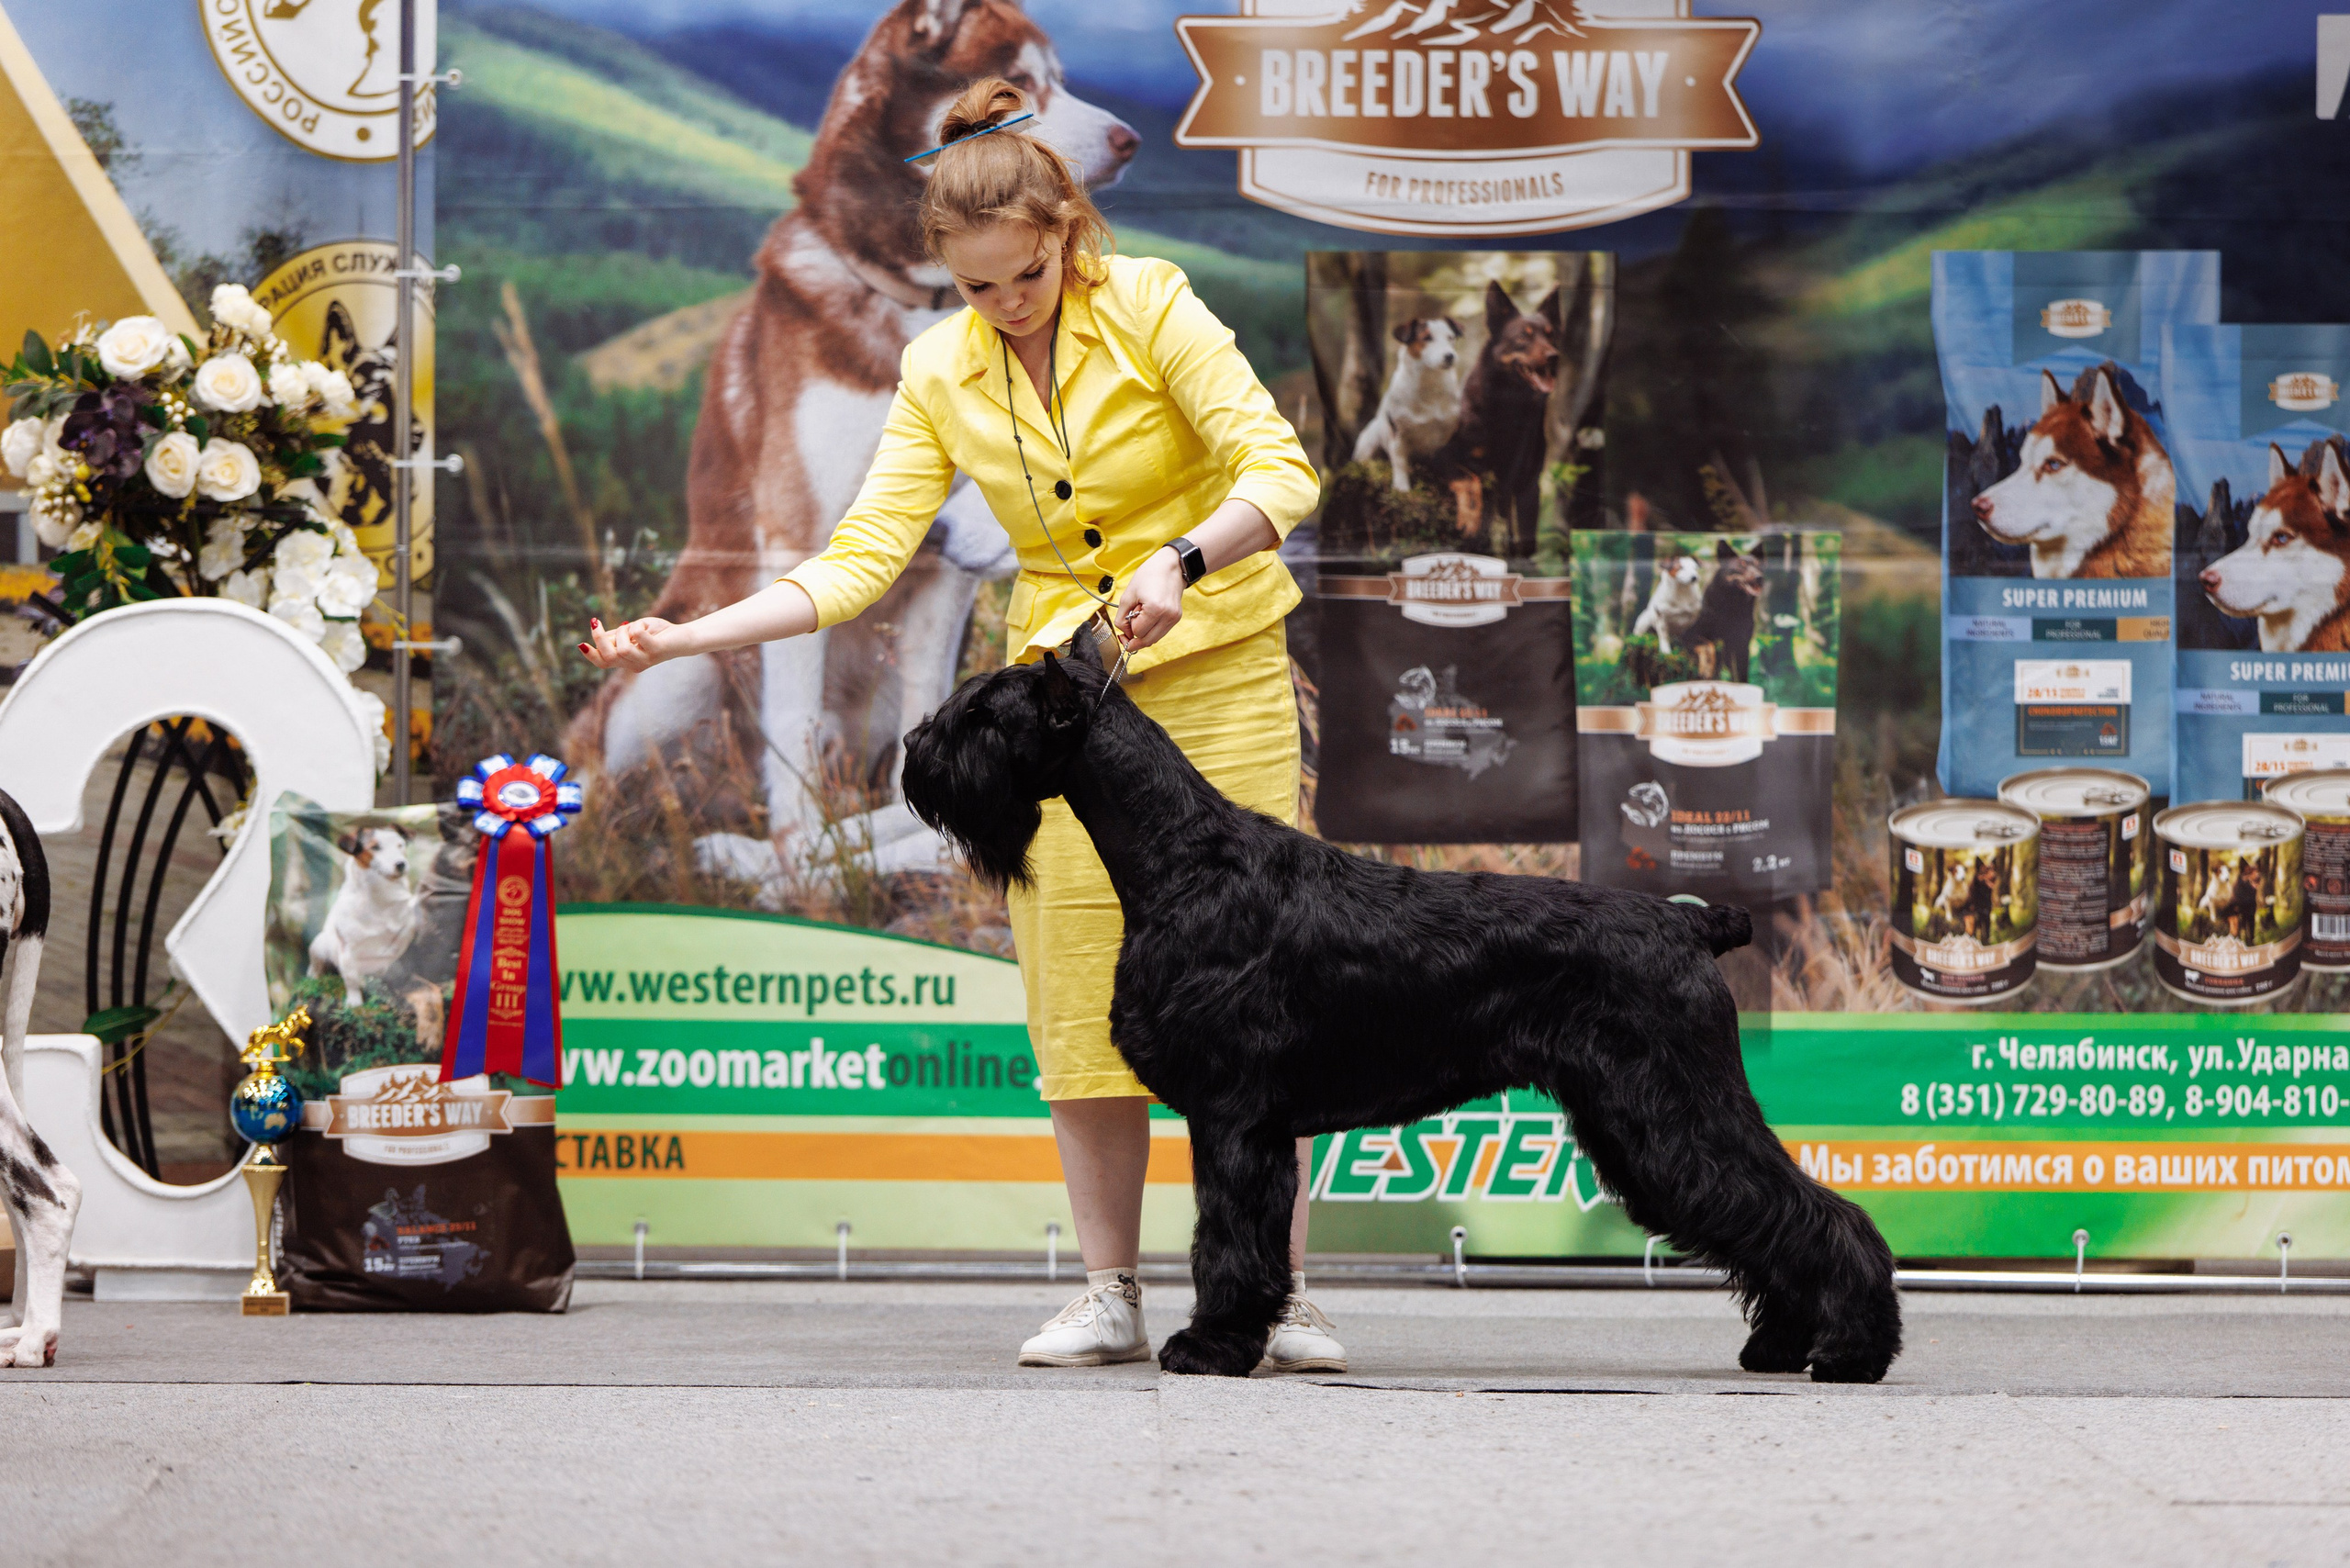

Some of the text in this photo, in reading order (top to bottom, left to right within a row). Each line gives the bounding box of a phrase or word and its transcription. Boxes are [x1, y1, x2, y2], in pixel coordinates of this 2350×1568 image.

[1259, 49, 1669, 118] BREEDER'S WAY
[1366, 171, 1564, 204] FOR PROFESSIONALS
[2002, 588, 2148, 609] SUPER PREMIUM
[2231, 661, 2286, 681] SUPER
[347, 1101, 483, 1129] BREEDER'S WAY
[2011, 1083, 2175, 1121] 729-80-89,
[2184, 1084, 2350, 1116] 8-904-810-
[1798, 1144, 1863, 1183] Мы
[1871, 1143, 2073, 1184] заботимся
[2082, 1154, 2104, 1184] о
[2114, 1154, 2237, 1185] ваших
